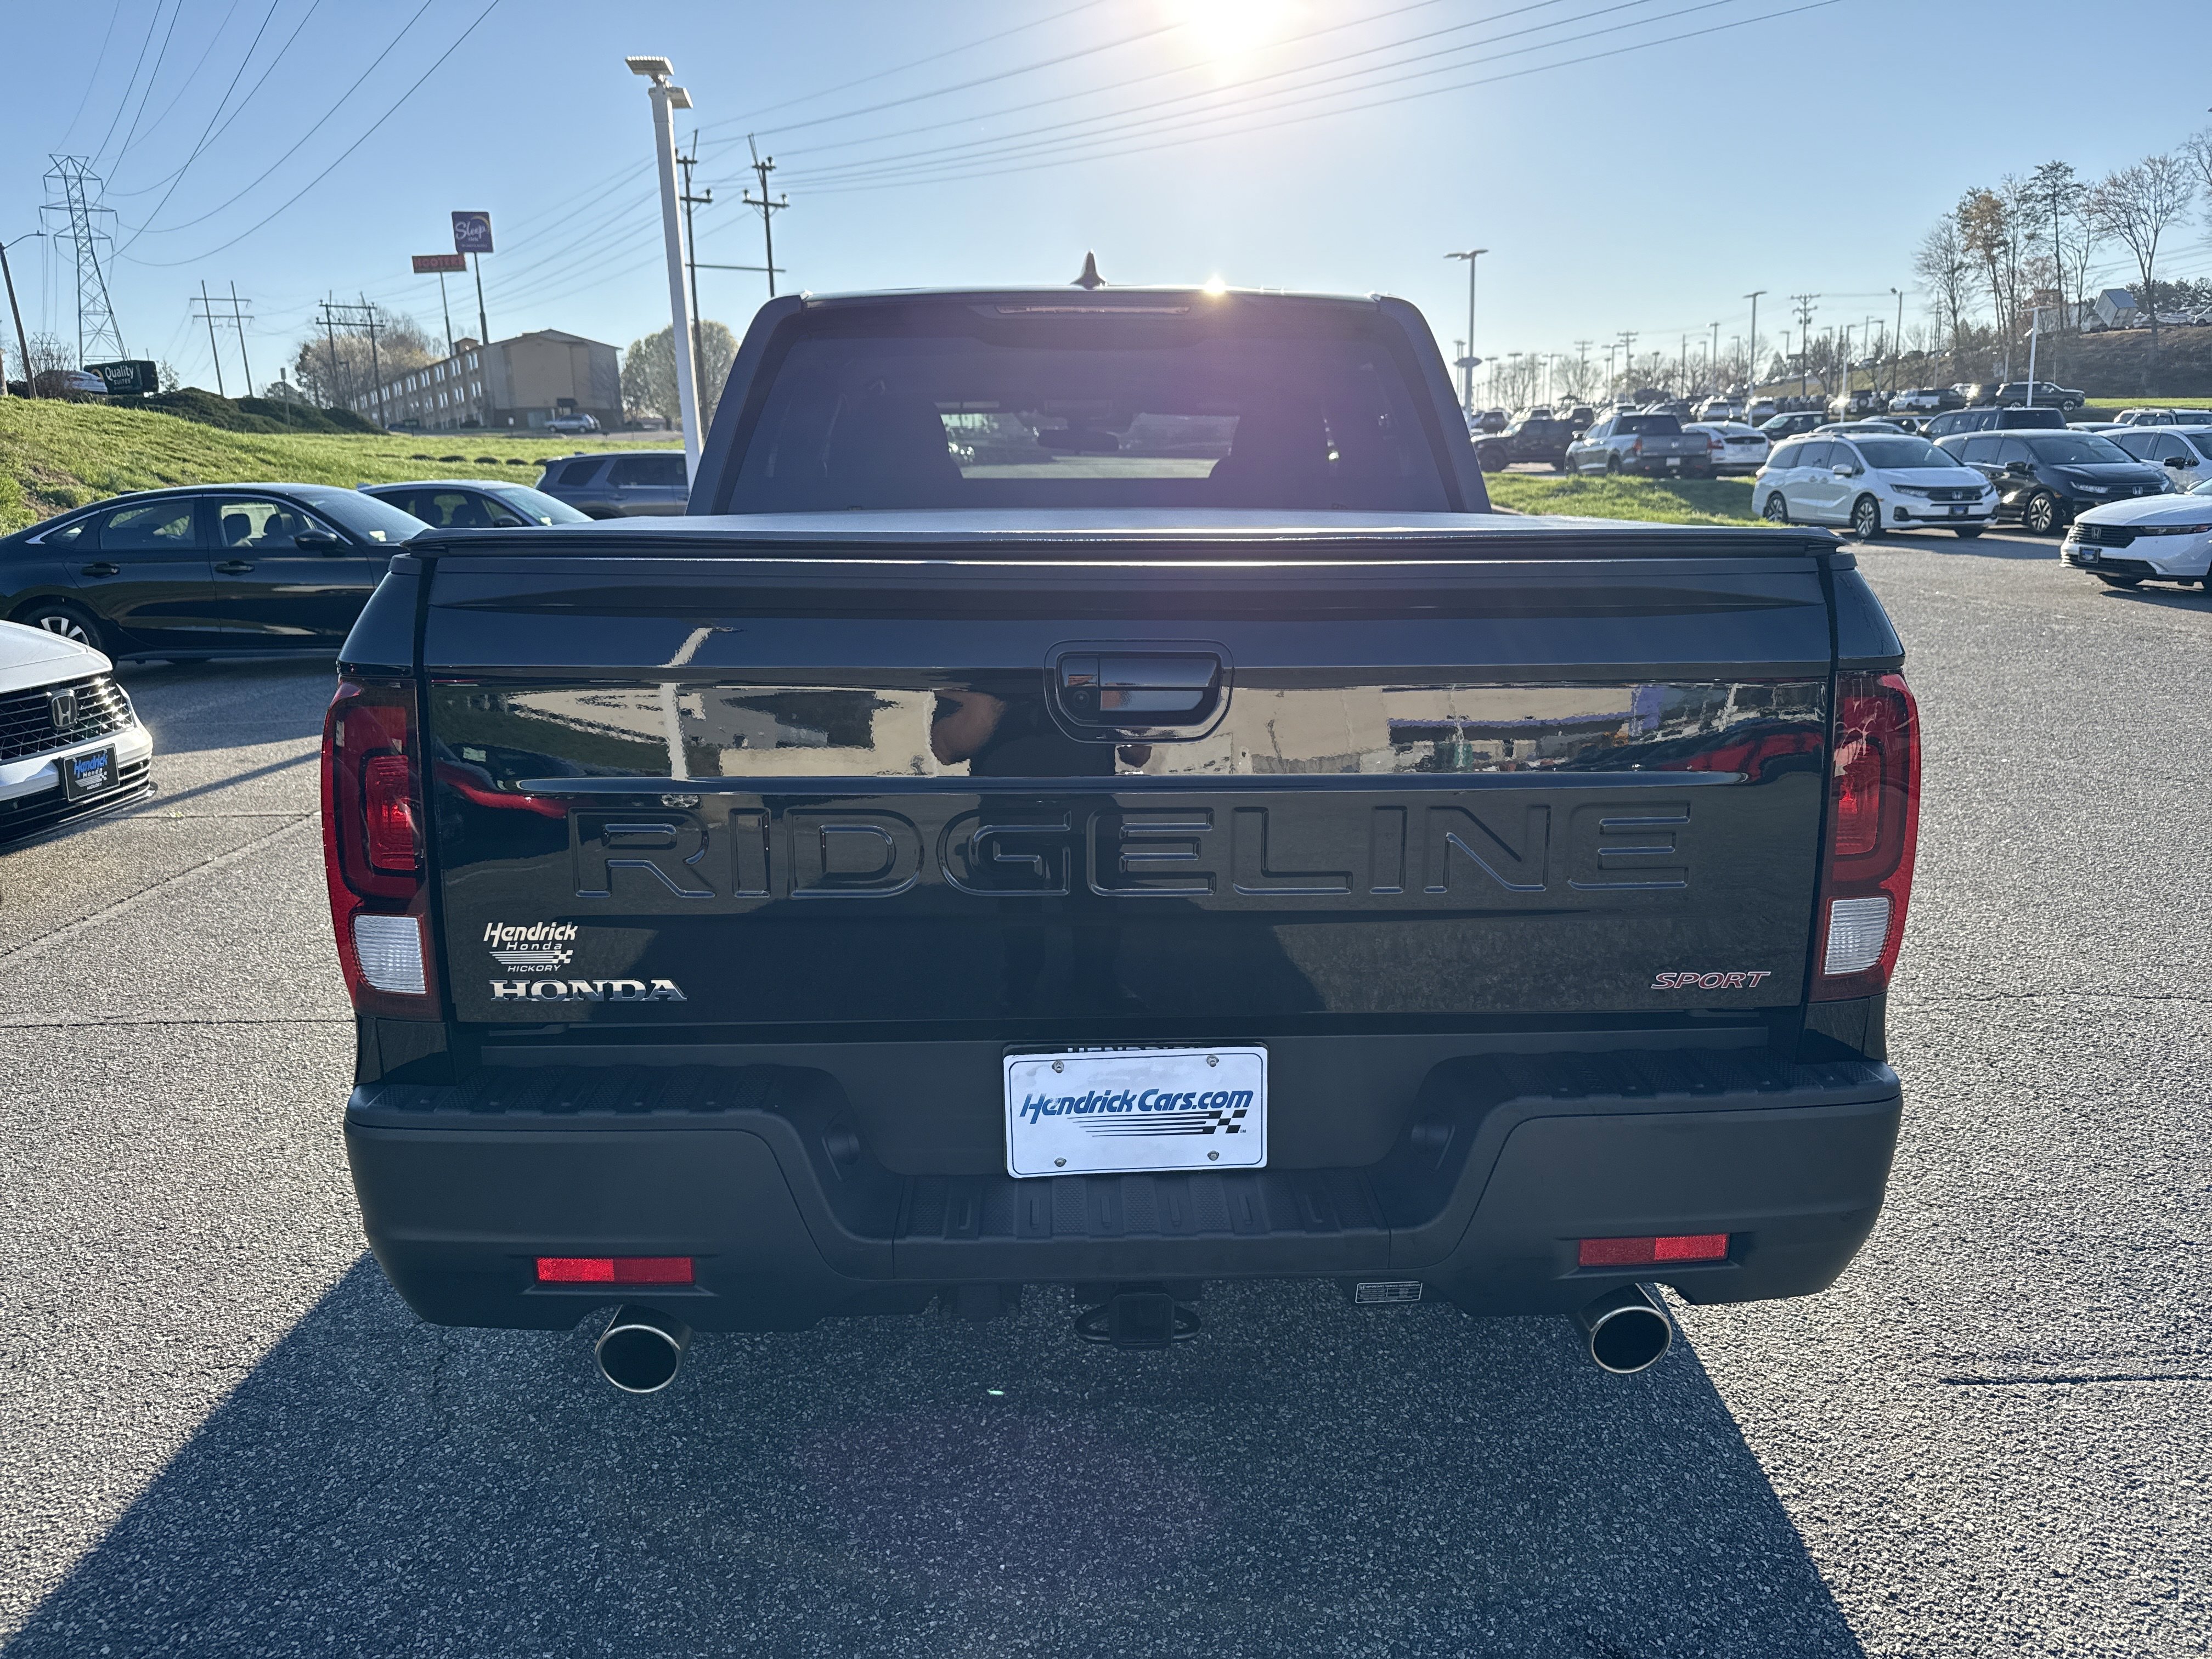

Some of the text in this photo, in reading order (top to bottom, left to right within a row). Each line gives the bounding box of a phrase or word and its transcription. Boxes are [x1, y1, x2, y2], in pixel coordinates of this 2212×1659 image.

[455, 221, 487, 240] Sleep
[105, 364, 134, 381] Quality
[74, 751, 108, 778] Hendrick
[82, 768, 103, 778] Honda
[568, 801, 1691, 900] RIDGELINE
[483, 921, 579, 947] Hendrick
[506, 941, 562, 951] Honda
[507, 964, 561, 972] HICKORY
[1650, 971, 1771, 989] SPORT
[488, 978, 688, 1002] HONDA
